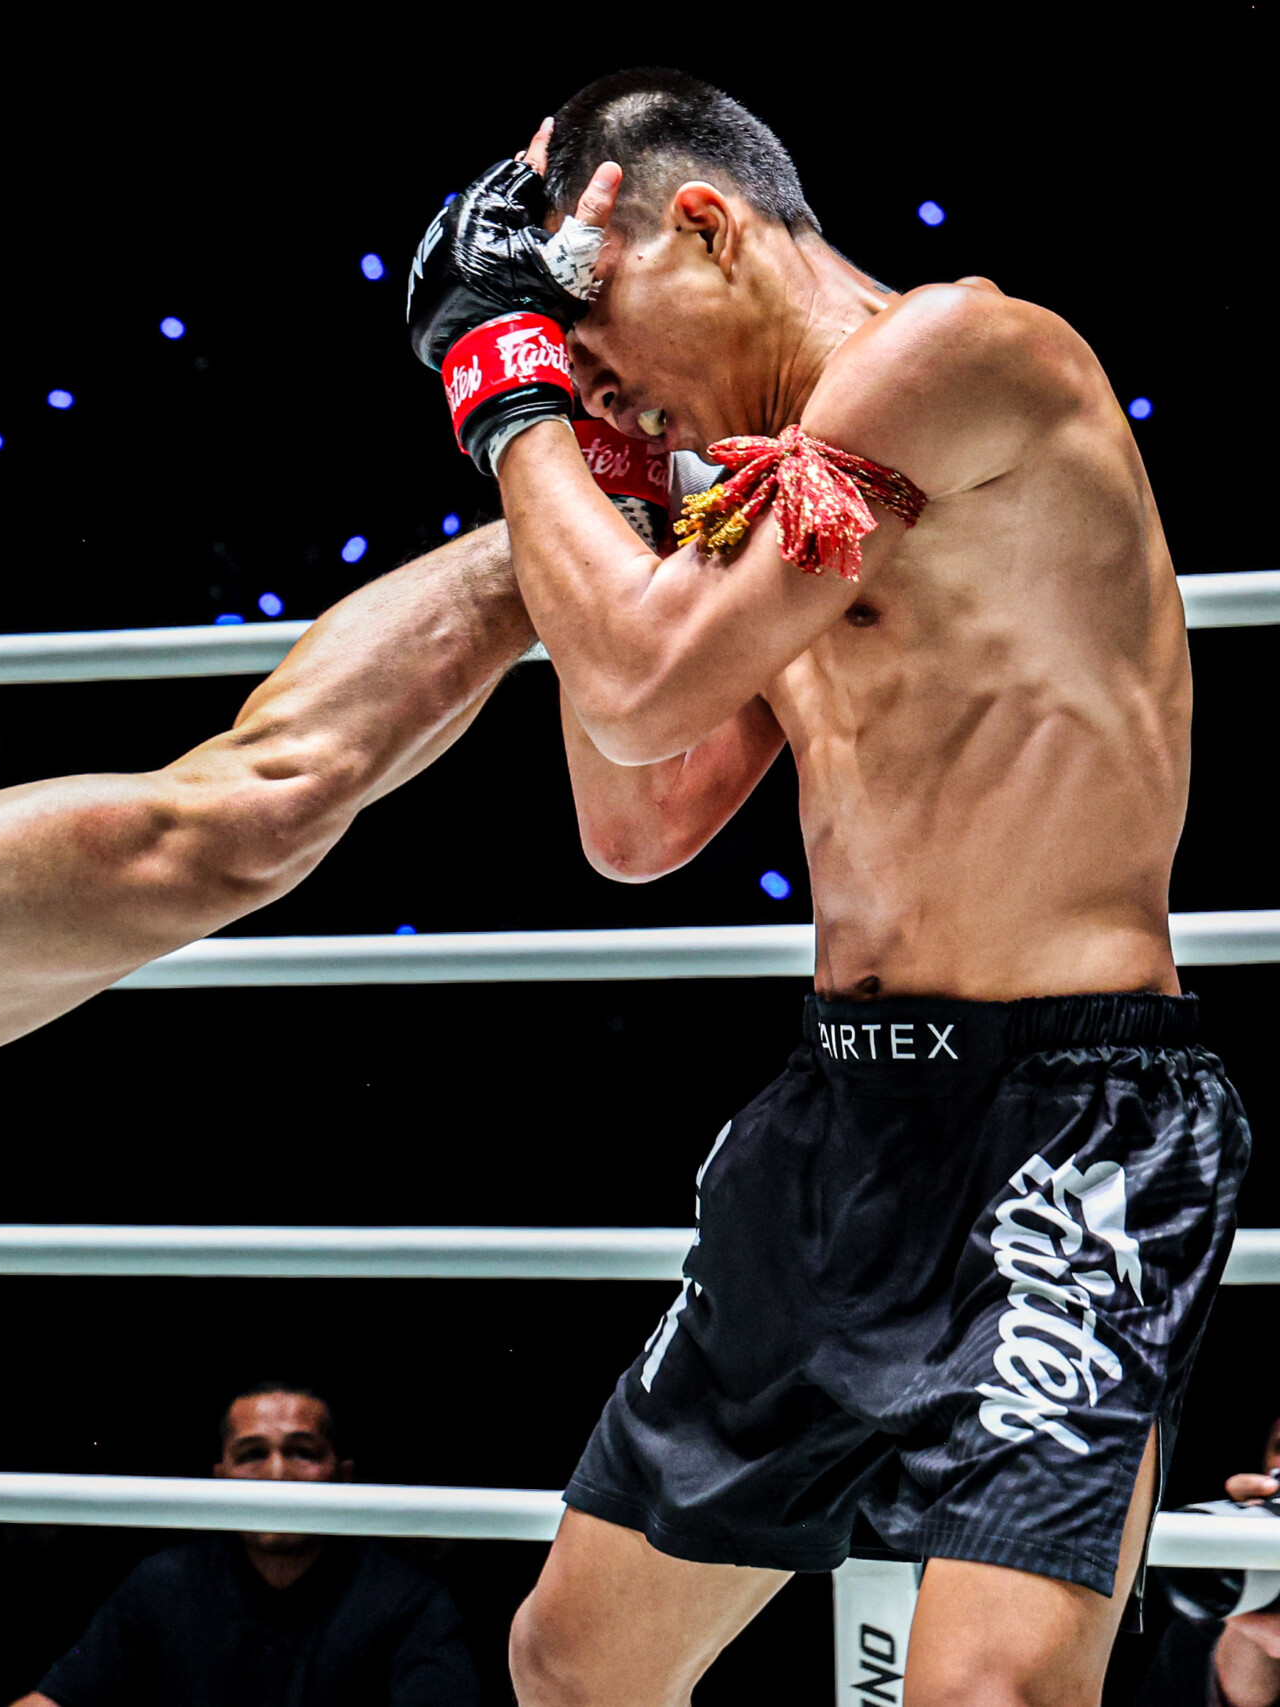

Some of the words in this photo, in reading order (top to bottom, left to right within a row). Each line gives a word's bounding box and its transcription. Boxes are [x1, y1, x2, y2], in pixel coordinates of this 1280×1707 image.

[818, 1021, 960, 1060] AIRTEX
[974, 1153, 1144, 1455] Fairtex
[851, 1623, 904, 1707] ON
